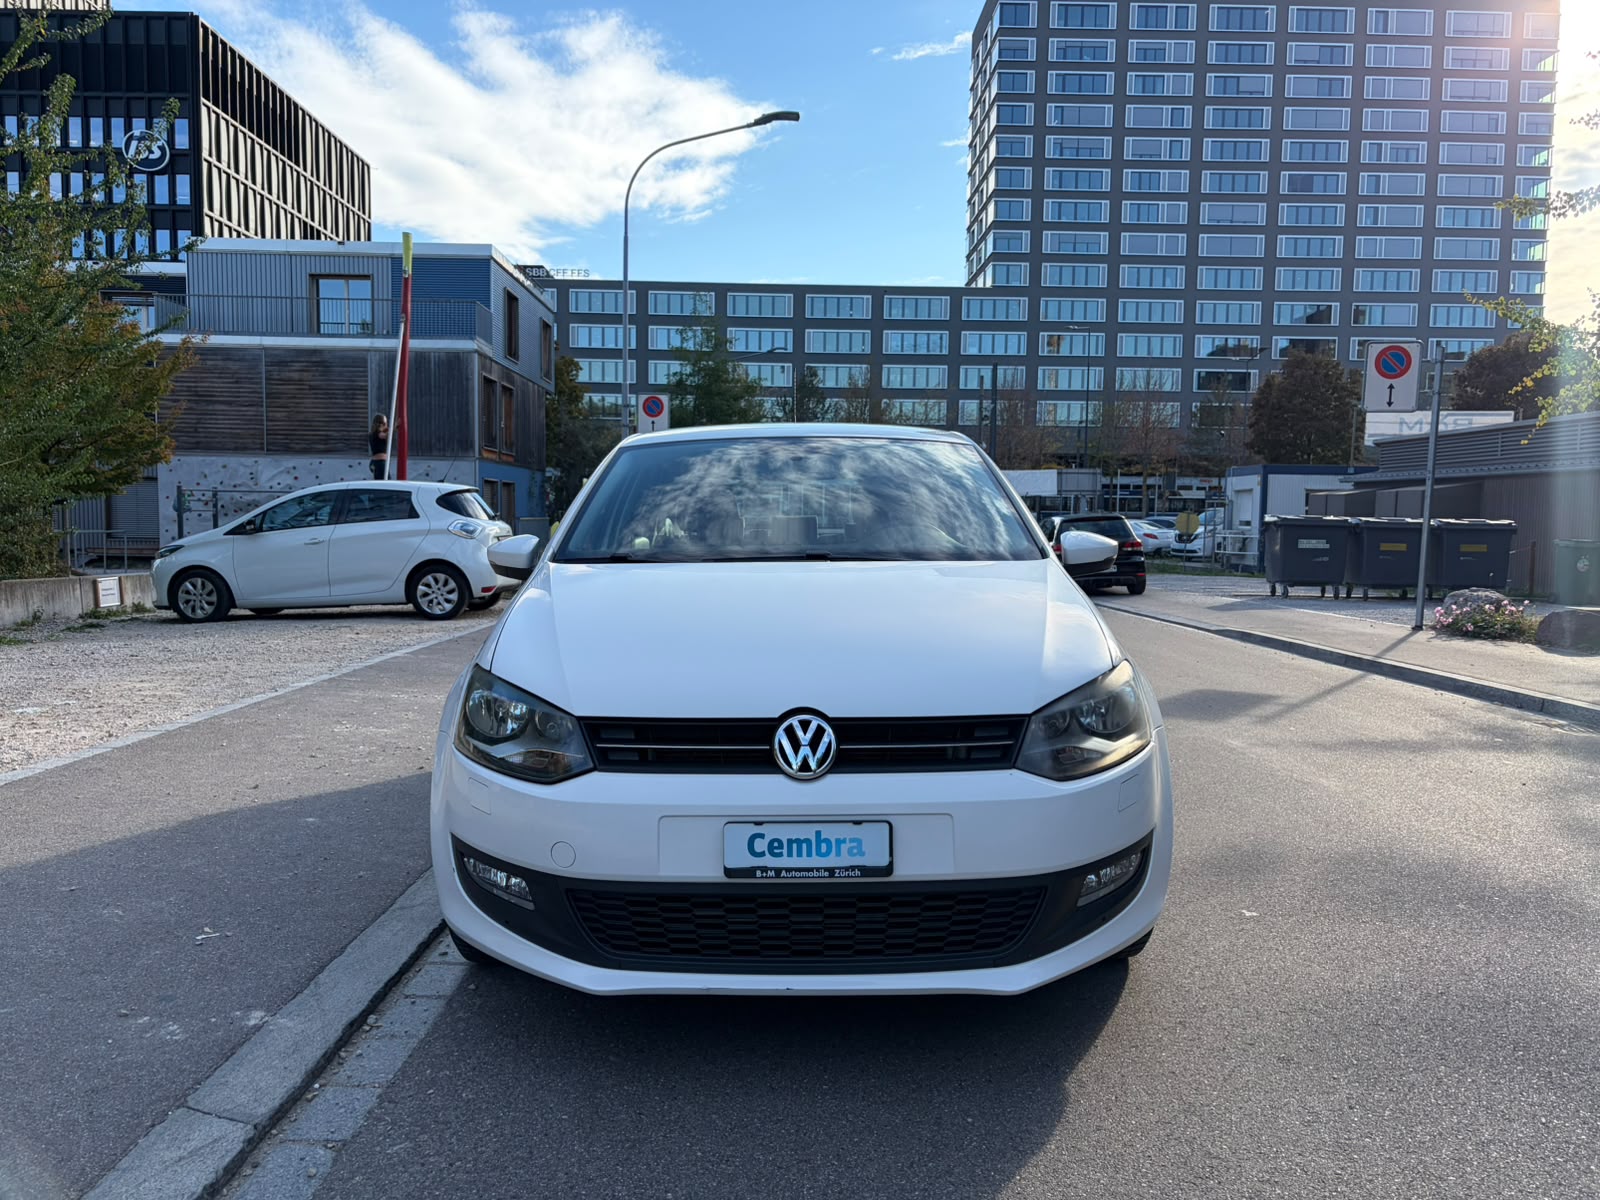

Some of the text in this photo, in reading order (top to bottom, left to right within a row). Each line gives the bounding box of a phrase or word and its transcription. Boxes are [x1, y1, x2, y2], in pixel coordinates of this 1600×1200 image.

[525, 267, 590, 278] SBB CFF FFS
[776, 716, 835, 778] VW
[747, 830, 866, 859] Cembra
[755, 868, 861, 878] B+M Automobile Zürich
